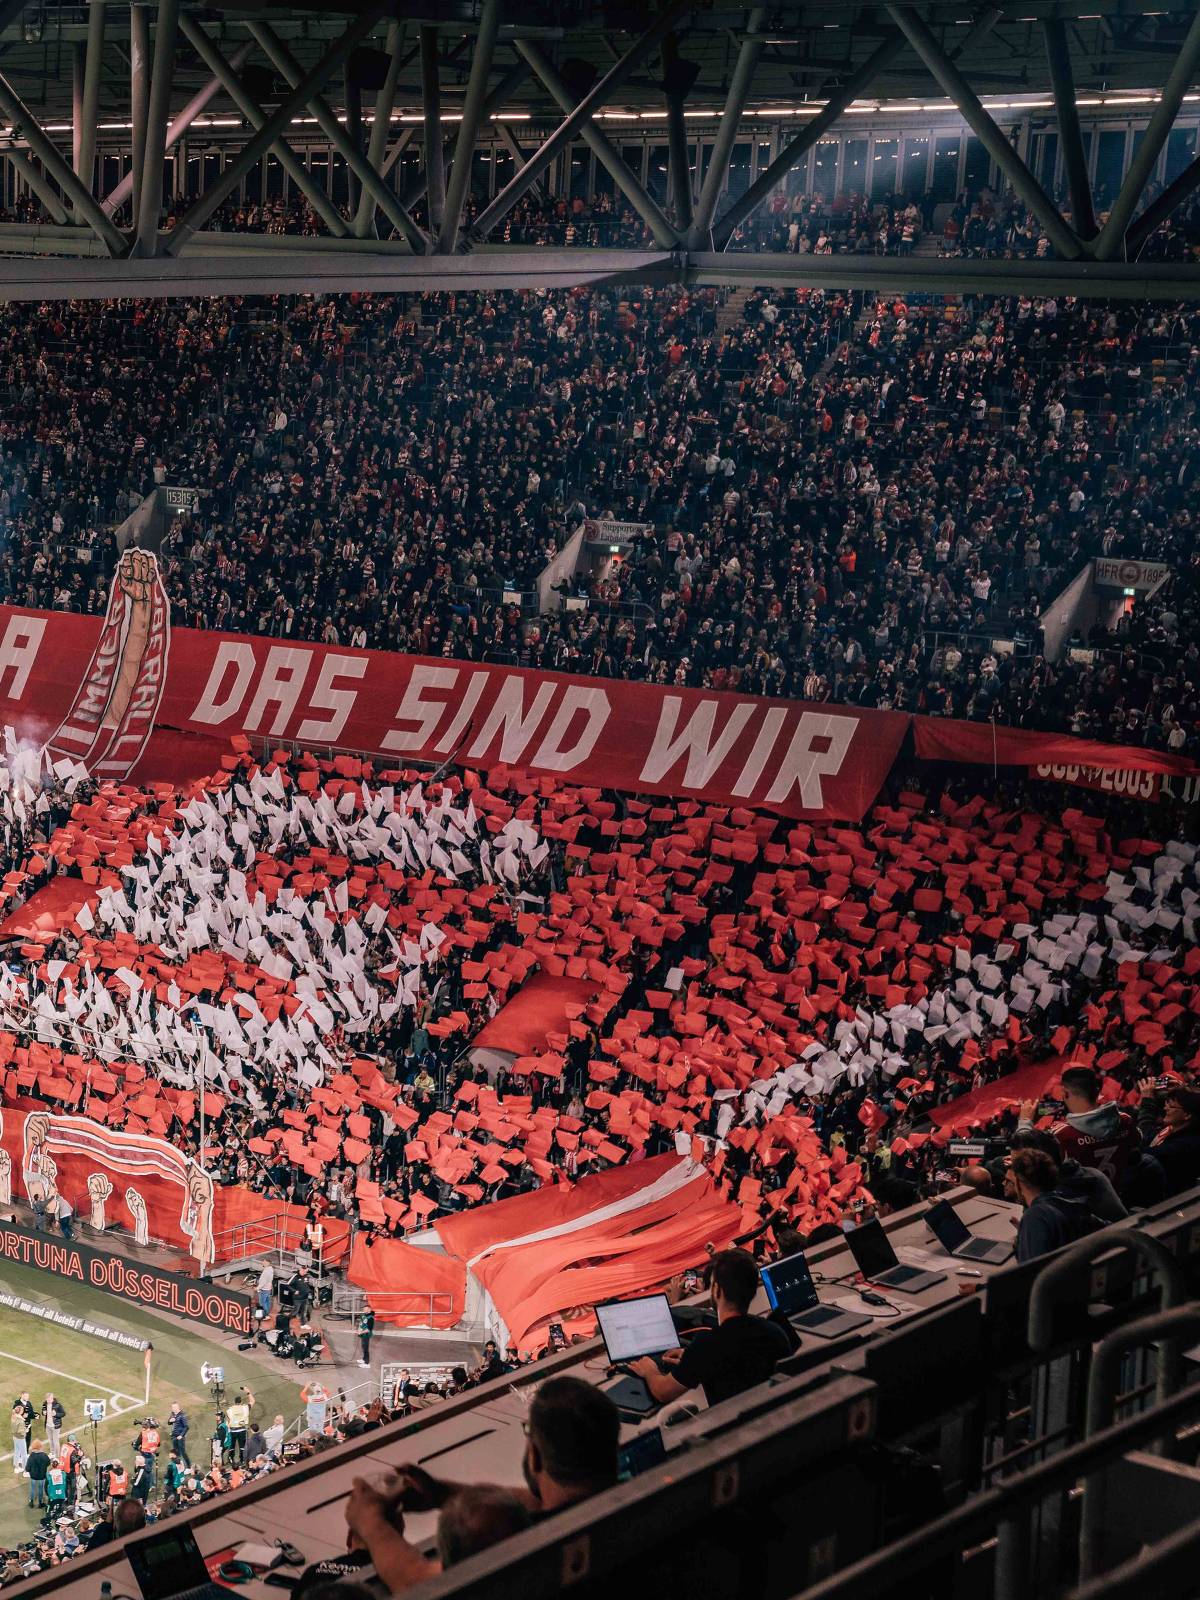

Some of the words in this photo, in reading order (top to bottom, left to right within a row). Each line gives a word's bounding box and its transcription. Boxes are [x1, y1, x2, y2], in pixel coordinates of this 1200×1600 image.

[168, 491, 182, 503] 153
[189, 641, 369, 742] DAS
[379, 664, 612, 772] SIND
[638, 695, 861, 809] WIR
[19, 1302, 31, 1312] me
[31, 1304, 44, 1317] and
[44, 1307, 53, 1320] all
[53, 1311, 75, 1326] hotels
[83, 1323, 95, 1334] me
[94, 1326, 108, 1338] and
[108, 1330, 117, 1342] all
[117, 1332, 141, 1348] hotels
